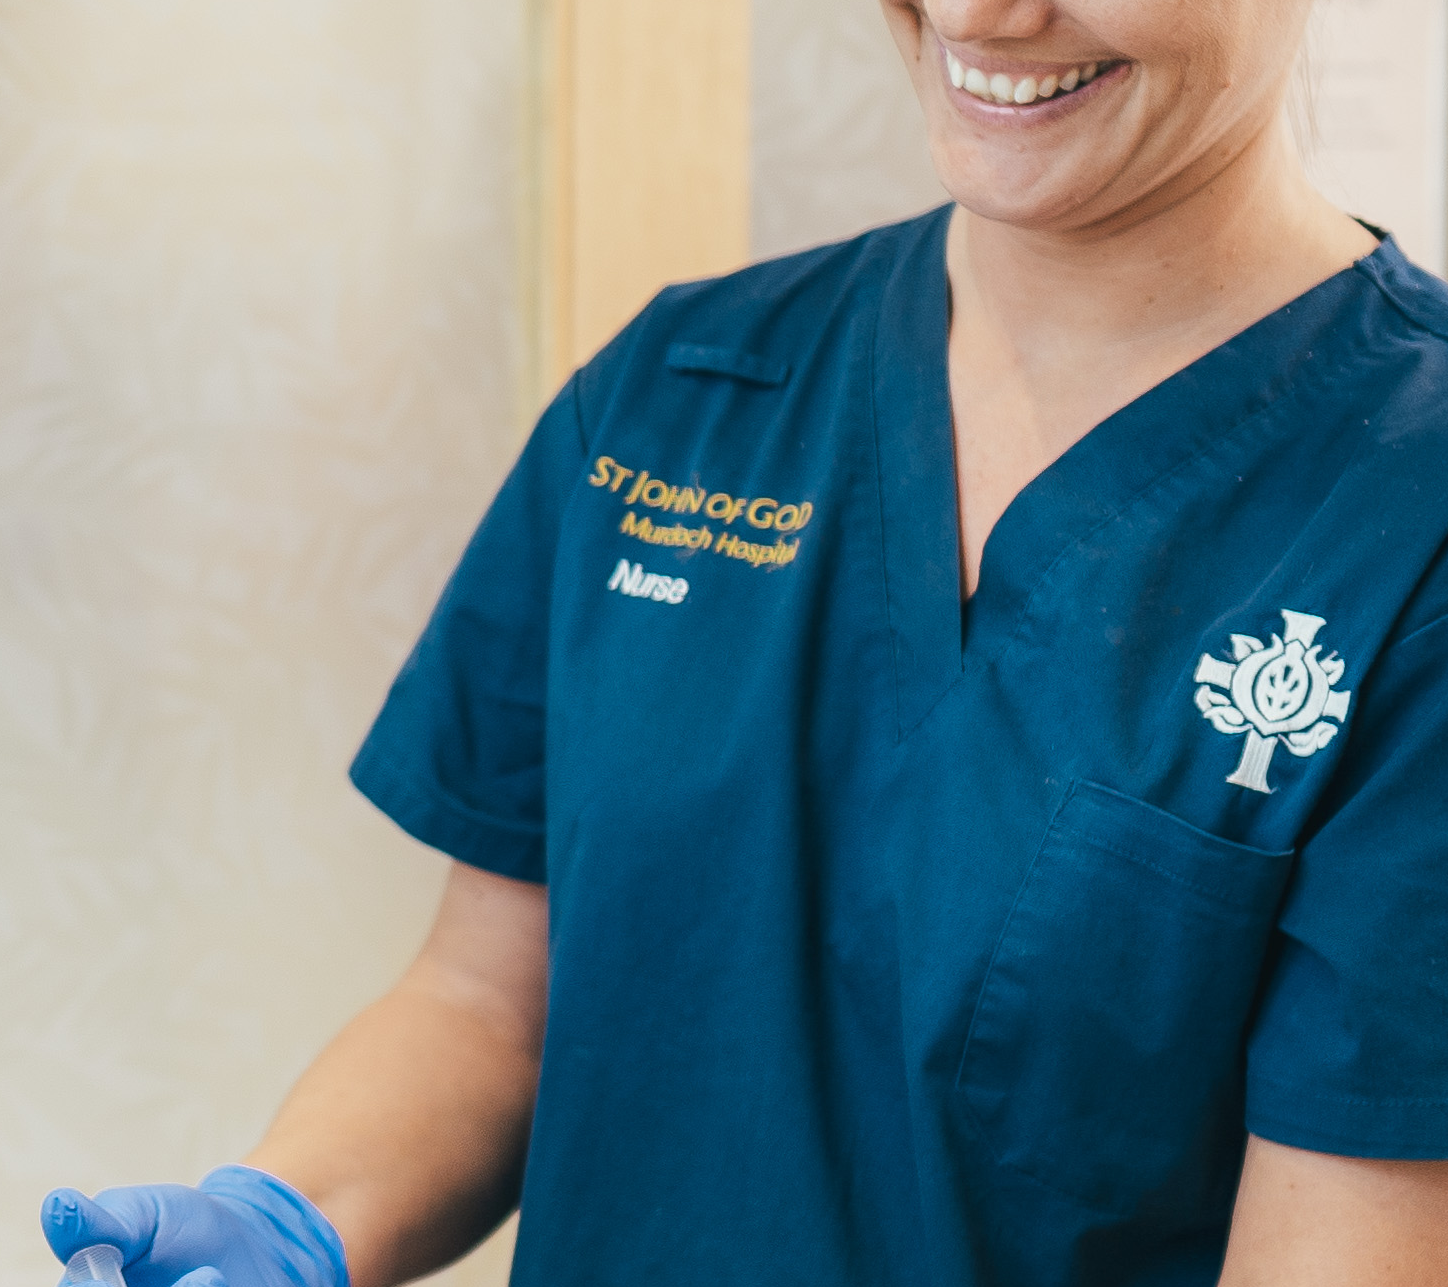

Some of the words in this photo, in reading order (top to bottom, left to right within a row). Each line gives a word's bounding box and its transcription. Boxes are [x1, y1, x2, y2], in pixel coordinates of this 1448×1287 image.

[589, 456, 634, 492] ST
[625, 470, 706, 514] JOHN
[748, 498, 813, 531] GOD
[620, 511, 713, 550] Murdoch
[714, 532, 800, 569] Hospital
[608, 558, 690, 605] Nurse
